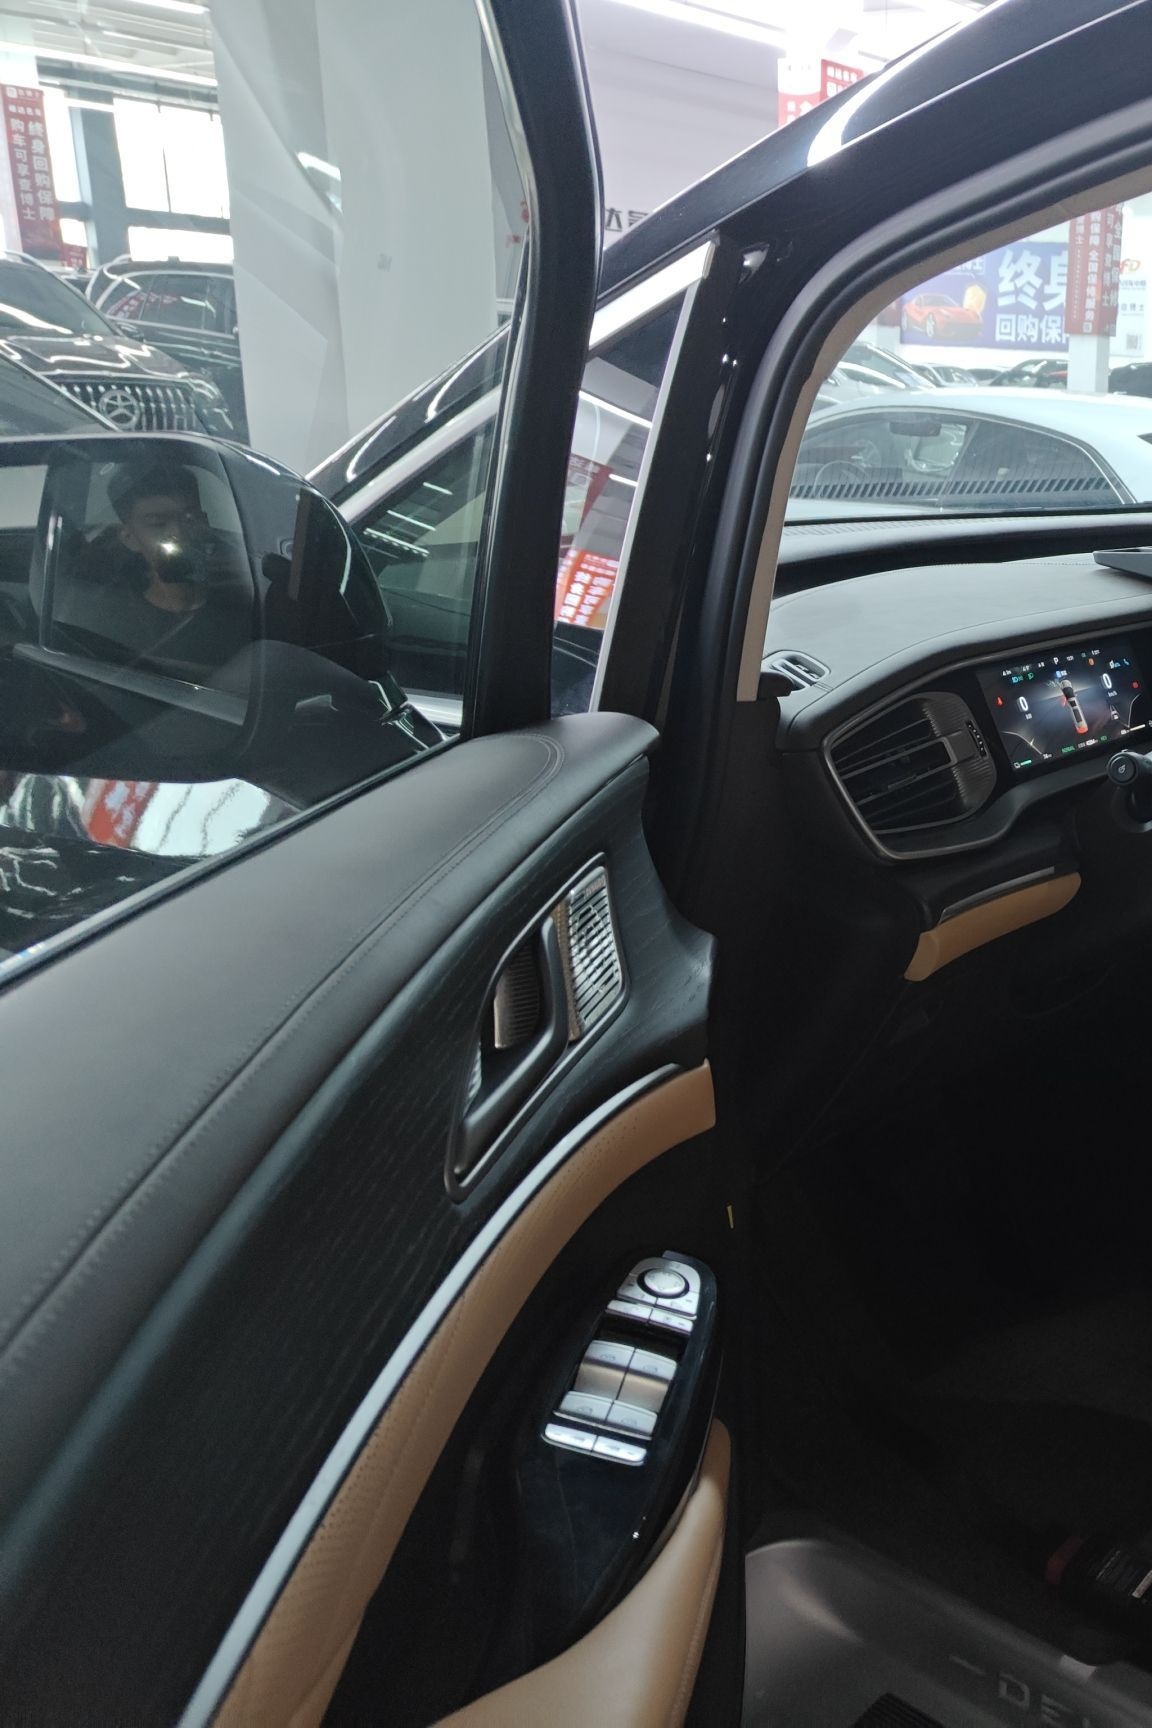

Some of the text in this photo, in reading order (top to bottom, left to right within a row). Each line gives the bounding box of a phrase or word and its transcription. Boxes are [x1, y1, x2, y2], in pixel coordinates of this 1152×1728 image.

[28, 120, 56, 222] 终身回购保障
[1102, 673, 1112, 689] 0
[1019, 696, 1029, 712] 0
